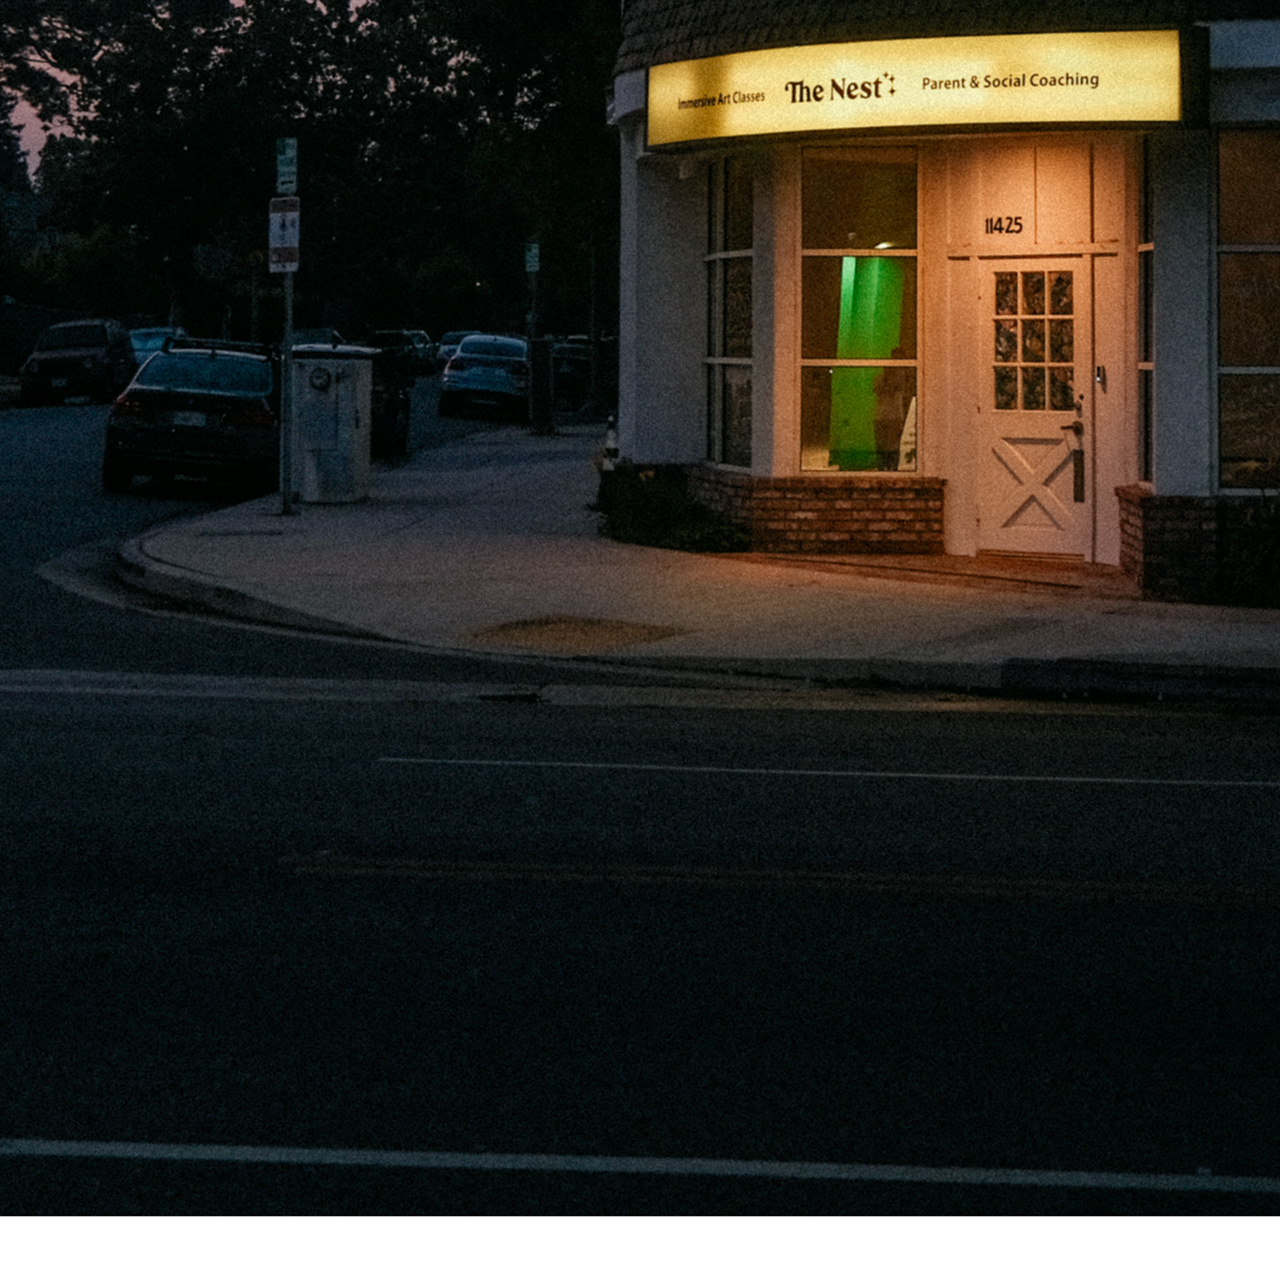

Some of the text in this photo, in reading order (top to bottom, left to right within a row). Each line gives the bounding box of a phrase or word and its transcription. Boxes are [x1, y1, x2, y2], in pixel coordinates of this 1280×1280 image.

[784, 77, 883, 103] The Nest
[922, 72, 1100, 90] Parent & Social Coaching
[678, 90, 766, 110] Immersive Art Classes
[985, 216, 1023, 234] 11425
